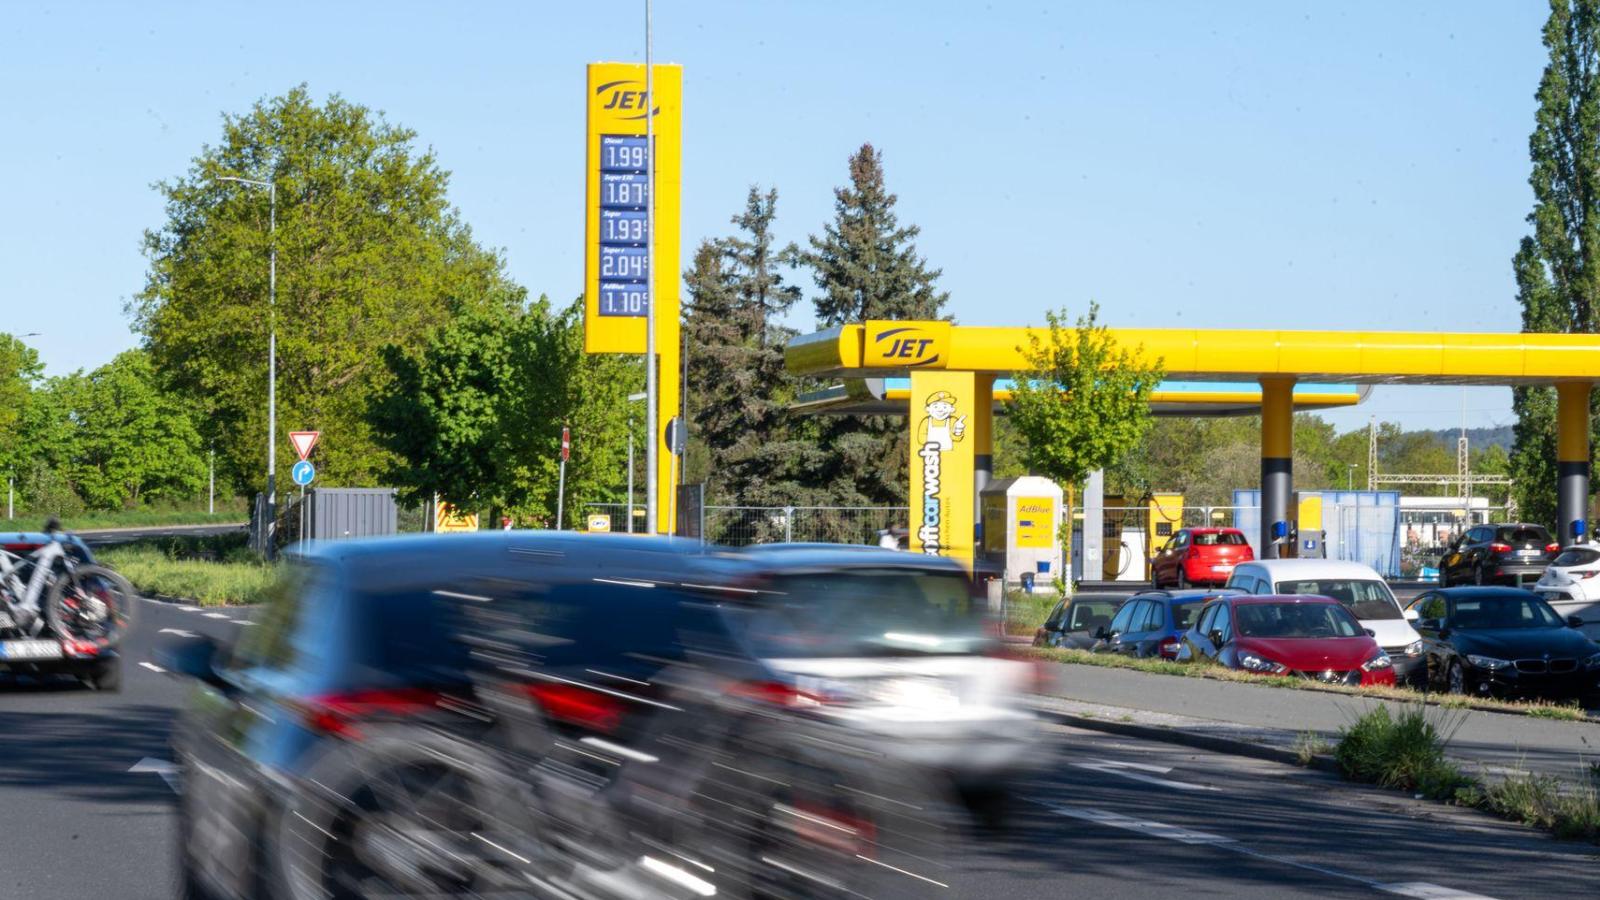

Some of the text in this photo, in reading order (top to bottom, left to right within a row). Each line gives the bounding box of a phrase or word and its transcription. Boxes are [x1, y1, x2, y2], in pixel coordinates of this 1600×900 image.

[603, 91, 648, 109] JET
[603, 210, 621, 218] Super
[882, 339, 934, 358] JET
[1019, 505, 1050, 513] AdBlue
